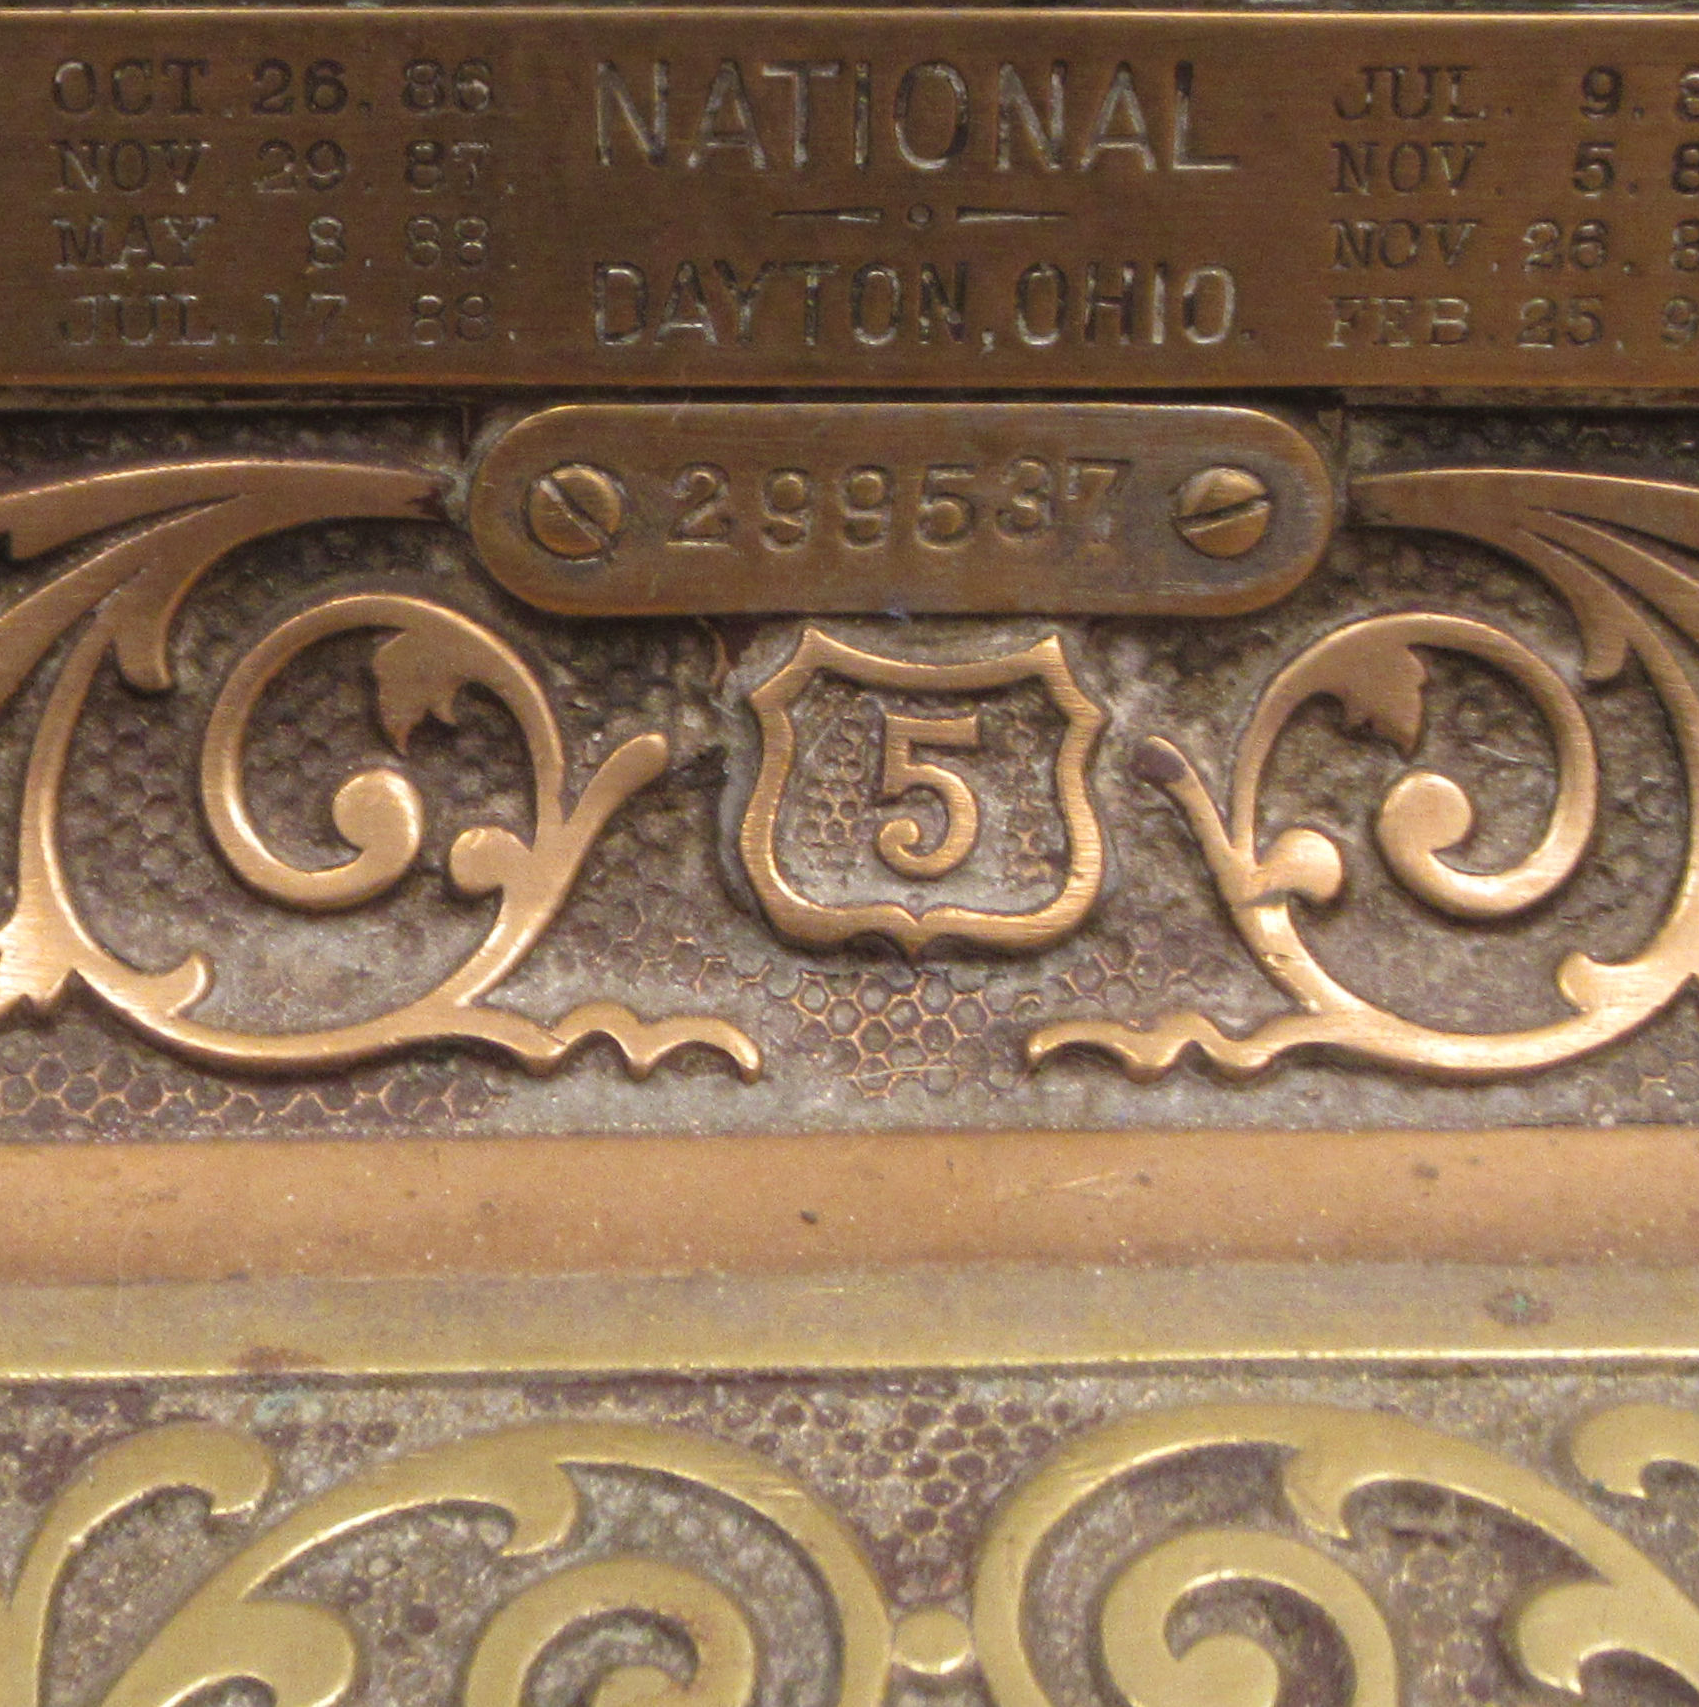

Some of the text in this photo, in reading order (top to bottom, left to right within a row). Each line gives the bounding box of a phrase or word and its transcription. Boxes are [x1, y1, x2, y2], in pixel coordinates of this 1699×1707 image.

[595, 58, 1242, 172] NATIONAL
[667, 456, 1133, 553] 299537
[875, 710, 983, 881] 5
